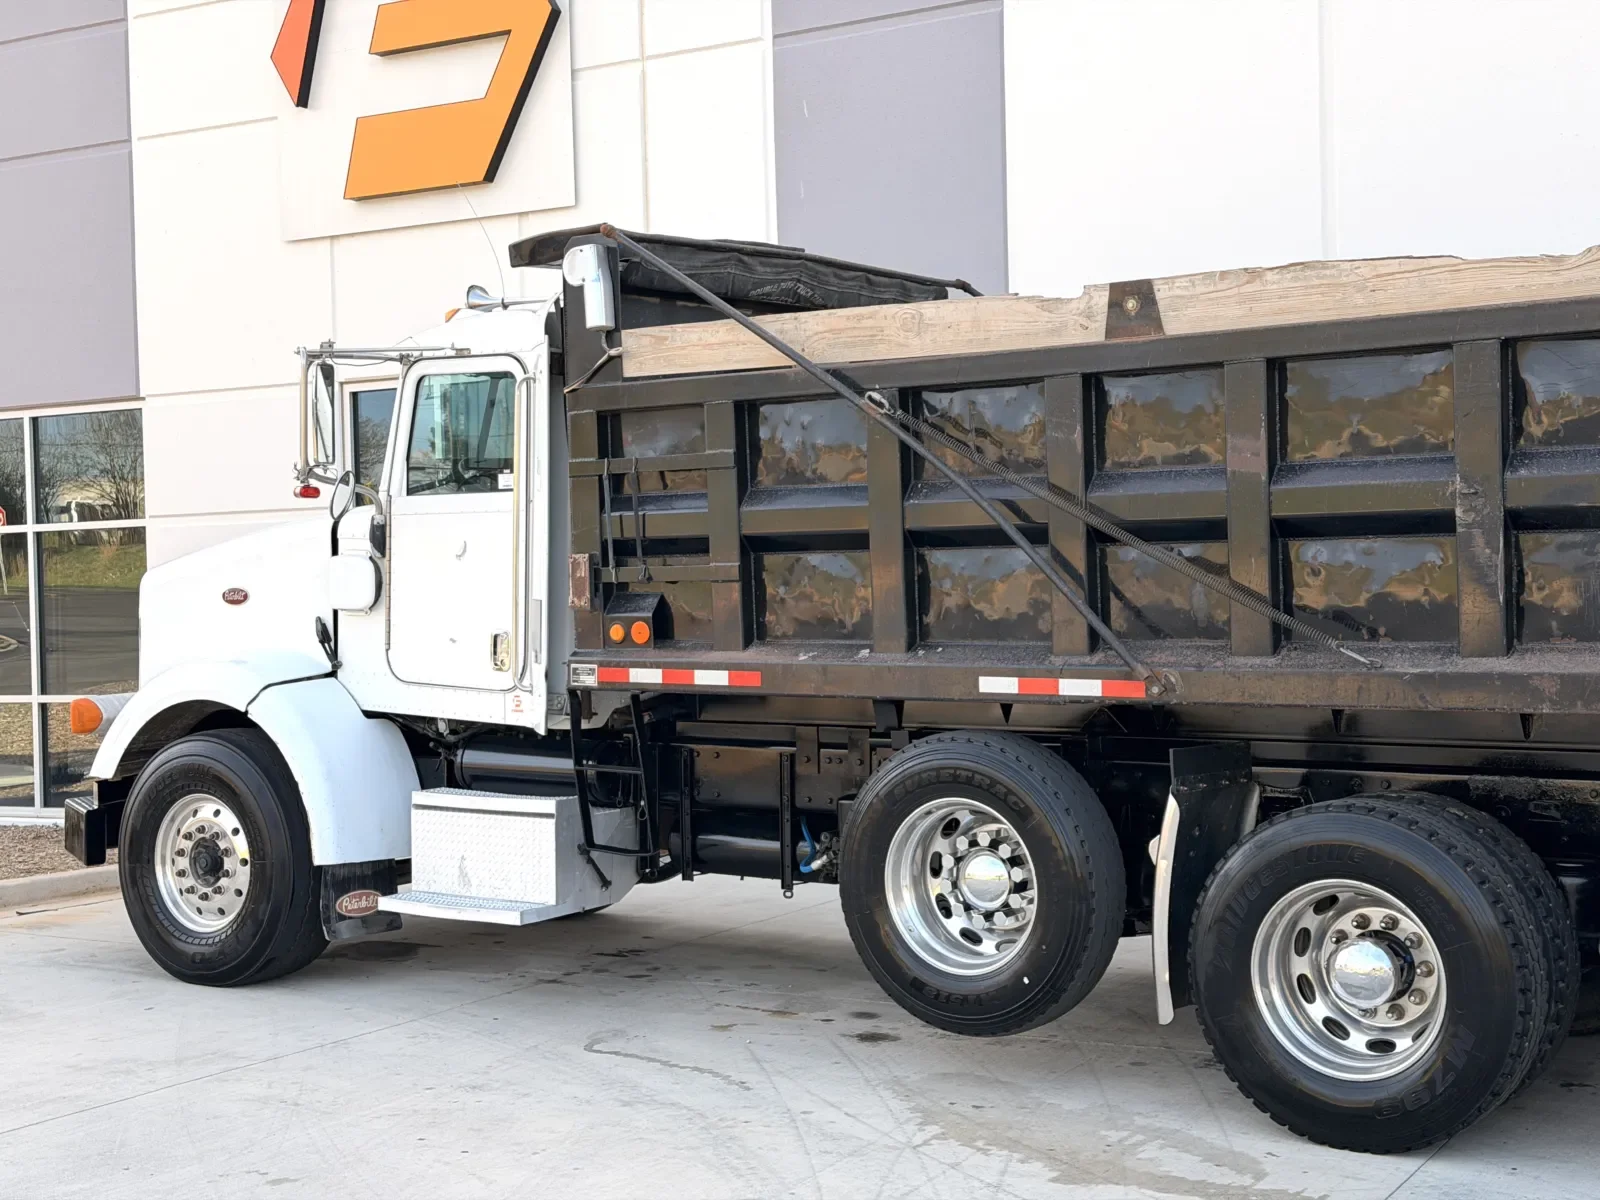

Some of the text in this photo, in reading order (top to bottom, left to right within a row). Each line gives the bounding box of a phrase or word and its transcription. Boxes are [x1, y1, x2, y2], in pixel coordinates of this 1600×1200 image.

[794, 282, 813, 298] TRUCK
[893, 768, 1026, 811] SURETRAC
[342, 895, 378, 912] Peterbilt
